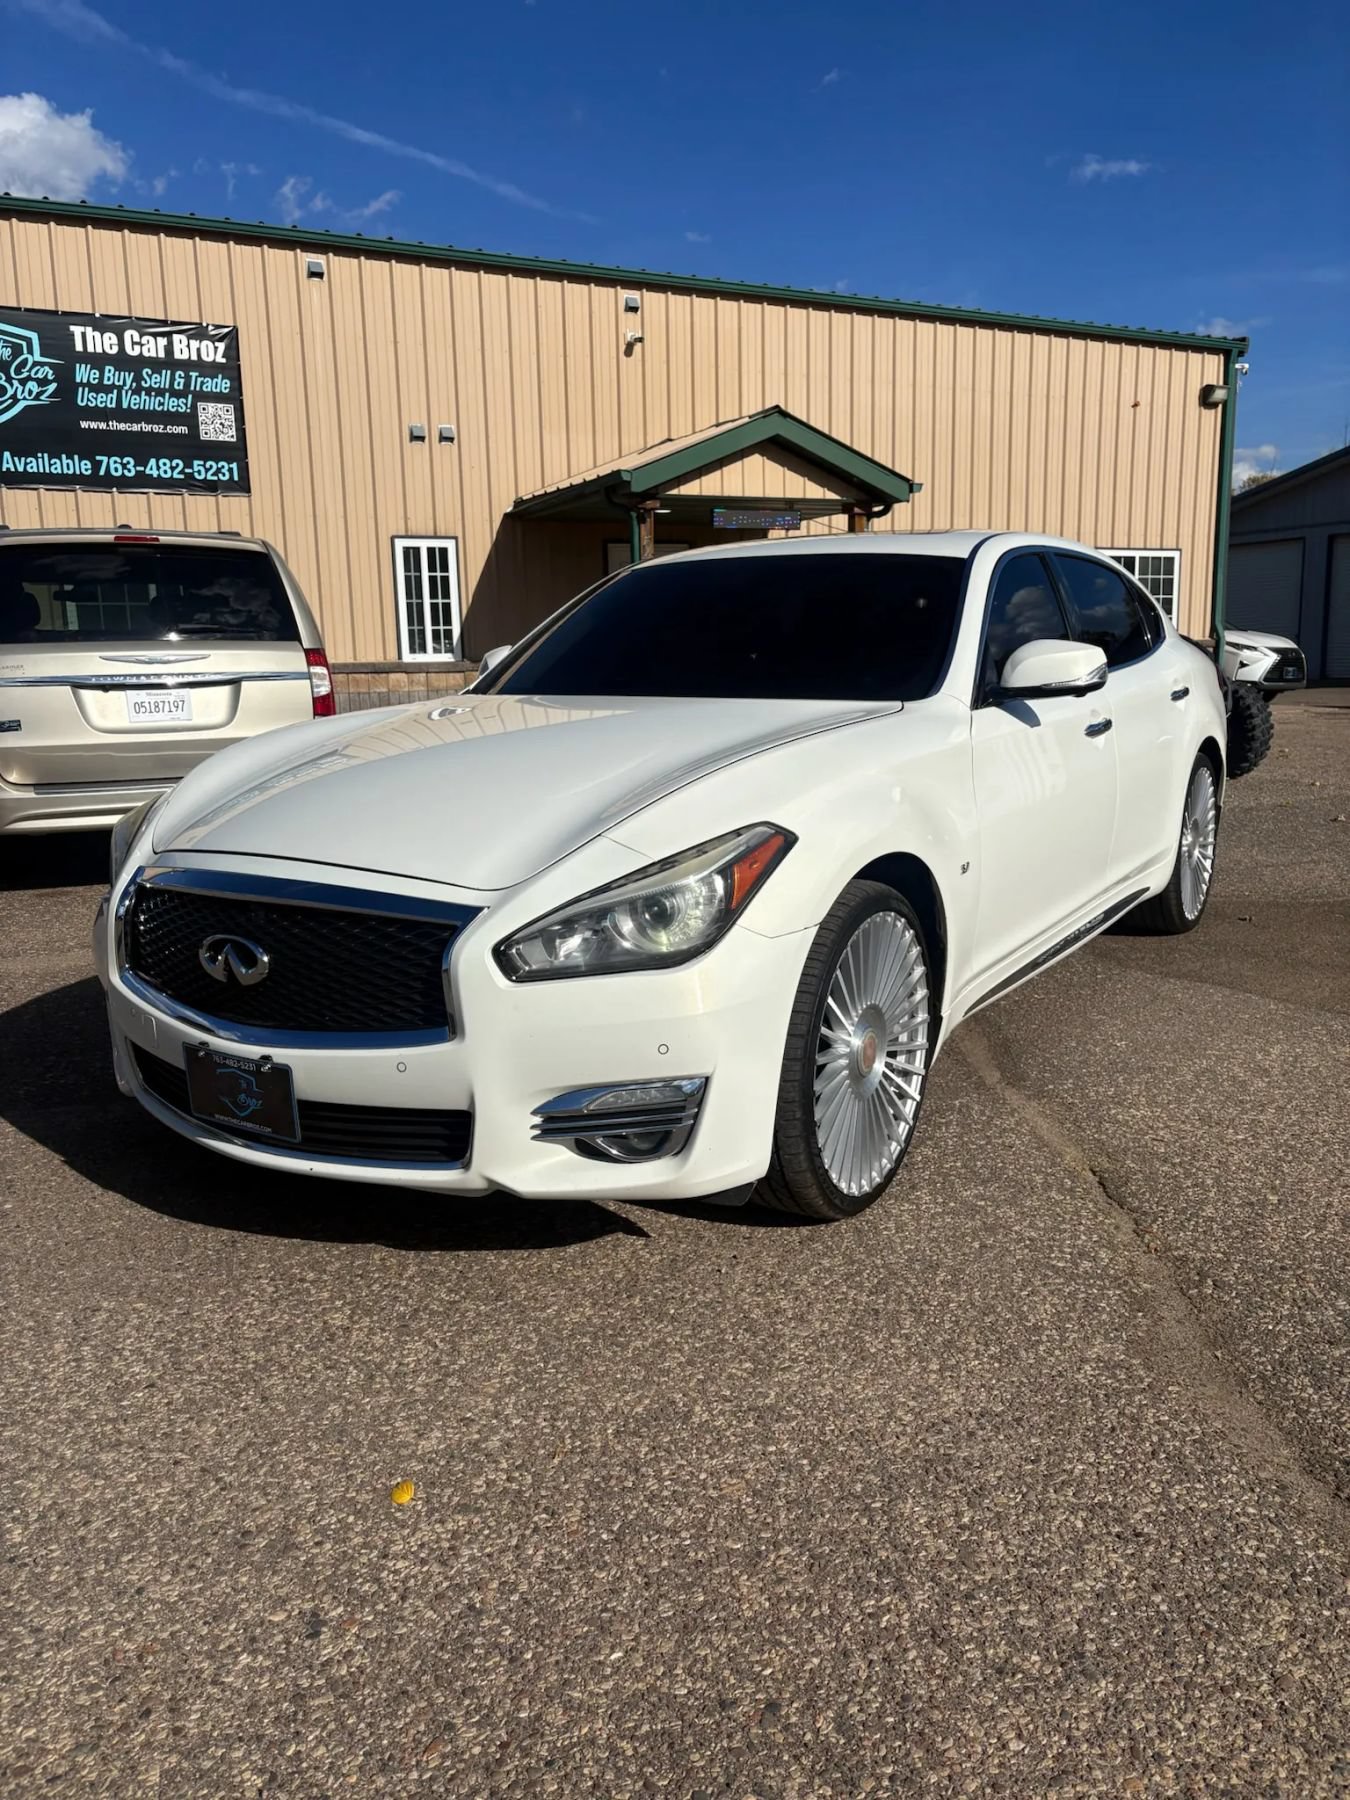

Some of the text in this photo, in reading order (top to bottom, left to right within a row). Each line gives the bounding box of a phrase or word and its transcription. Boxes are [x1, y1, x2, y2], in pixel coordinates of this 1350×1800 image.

[69, 325, 227, 363] The Car Broz
[10, 353, 55, 380] Car
[75, 363, 230, 393] We Buy, Sell & Trade
[76, 387, 192, 413] Used Vehicles!
[80, 420, 188, 435] www.thecarbroz.com
[1, 451, 239, 481] Available 763-482-5231
[133, 700, 185, 714] 05187197
[212, 1055, 257, 1072] 763-482-5231
